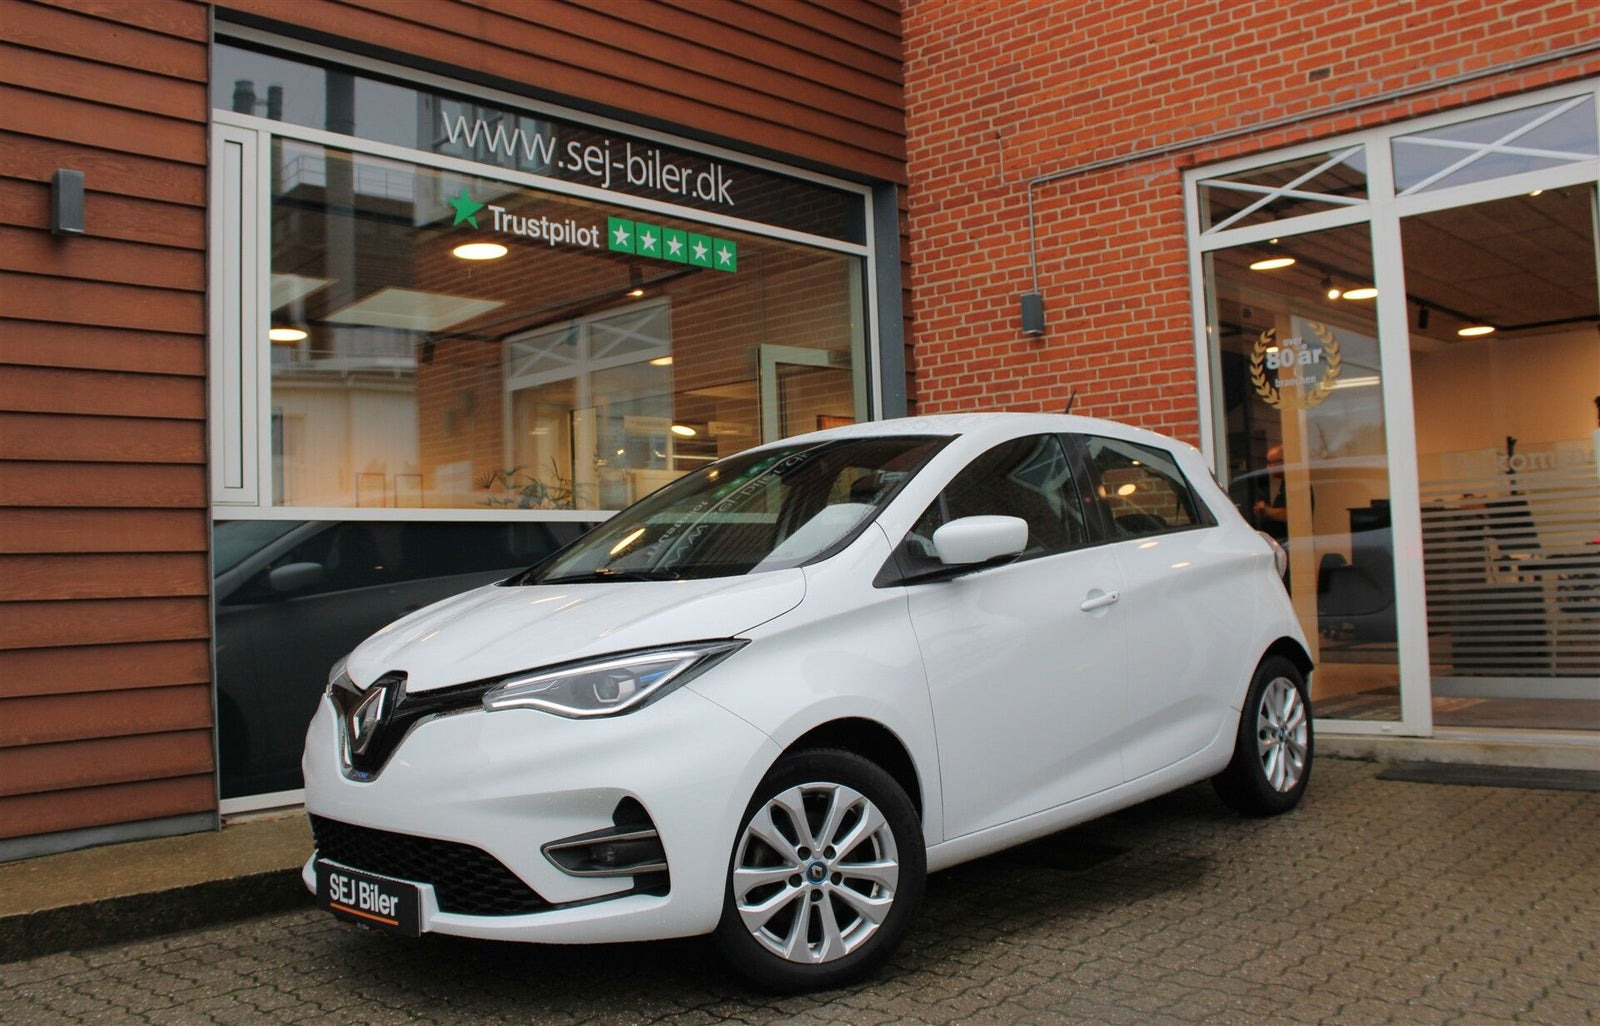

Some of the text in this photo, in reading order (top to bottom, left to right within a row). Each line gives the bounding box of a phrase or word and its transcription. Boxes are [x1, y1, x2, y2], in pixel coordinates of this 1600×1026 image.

[442, 111, 735, 206] www.sej-biler.dk
[488, 205, 600, 248] Trustpilot
[1266, 344, 1322, 370] 80 år
[329, 873, 398, 916] SEJ Biler
